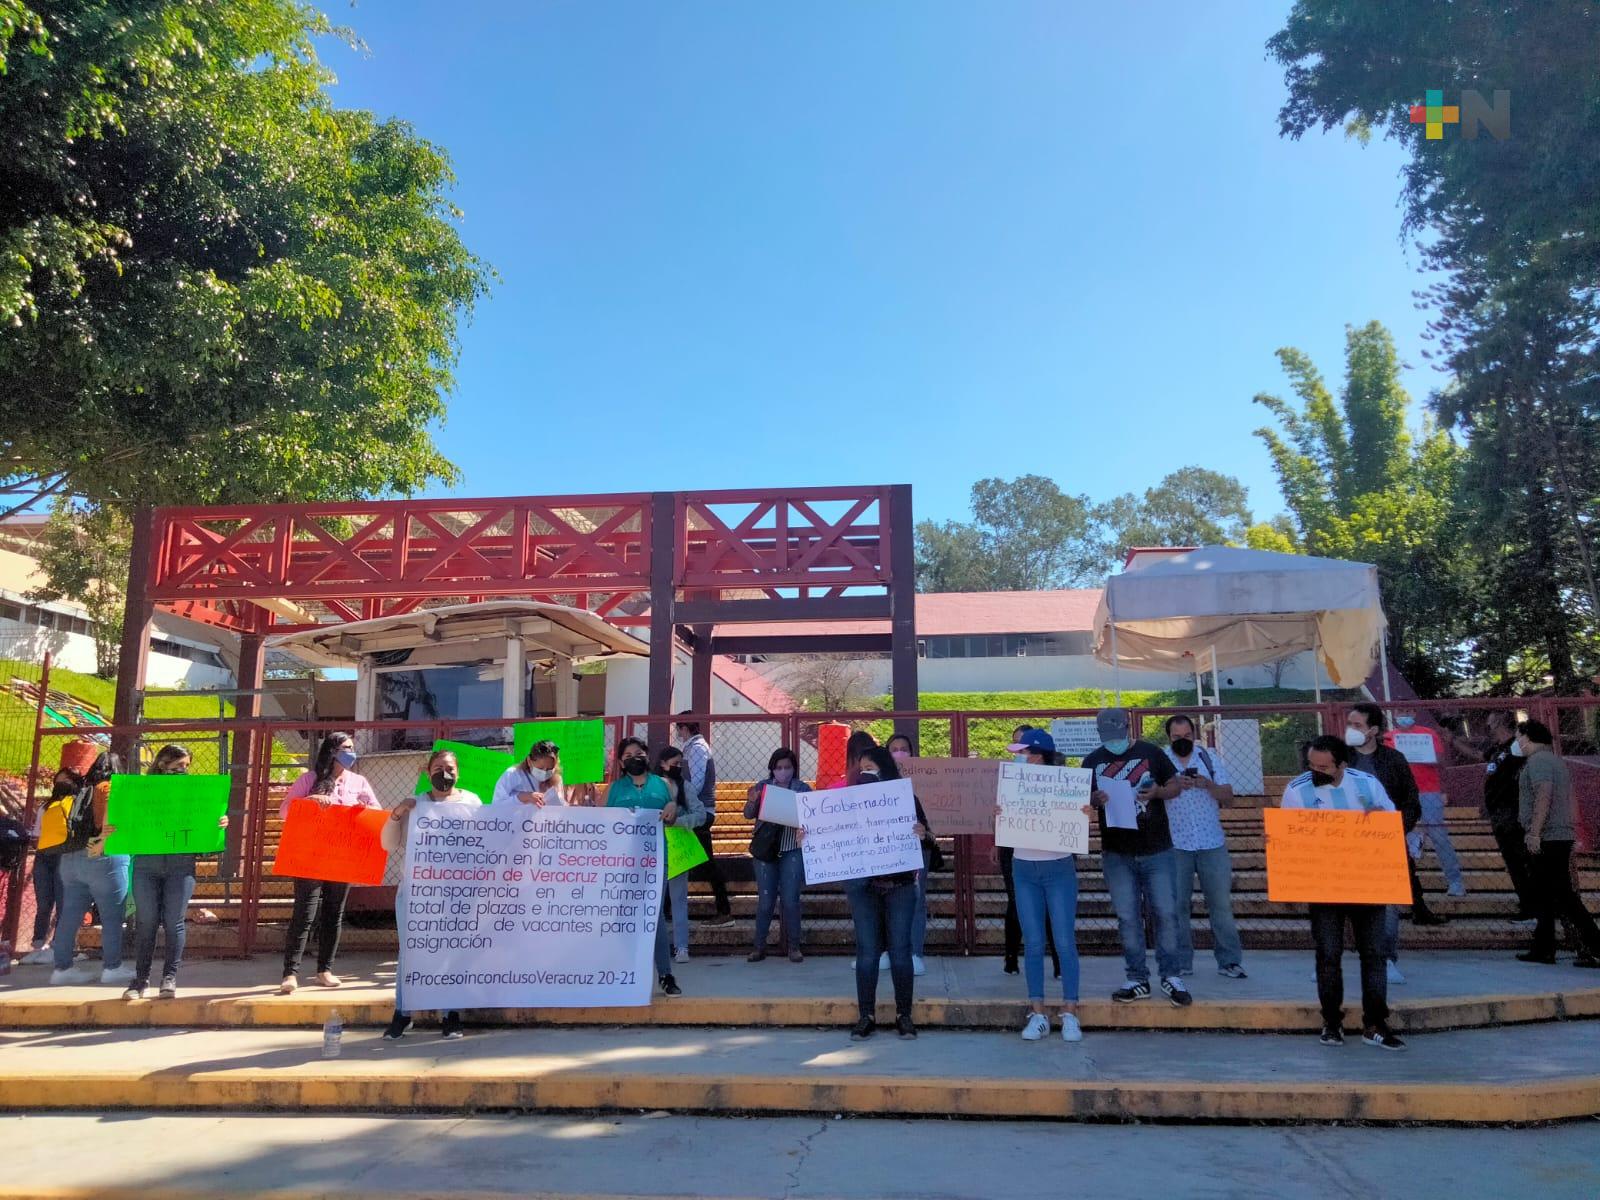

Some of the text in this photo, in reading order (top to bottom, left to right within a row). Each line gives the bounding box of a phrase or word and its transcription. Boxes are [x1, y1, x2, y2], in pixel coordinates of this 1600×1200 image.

[821, 793, 900, 815] Gobernador
[416, 816, 657, 836] Gobernador, Cuitláhuac García
[1288, 824, 1318, 835] BASE
[1326, 829, 1345, 839] DEL
[415, 832, 657, 852] Jiménez, solicitamos su
[804, 840, 816, 854] de
[873, 832, 885, 844] de
[414, 848, 657, 869] intervención en la Secretaria de
[806, 857, 823, 866] en
[827, 851, 837, 863] el
[412, 865, 657, 888] Educación de Veracruz para la
[411, 883, 657, 901] transparencia en el número
[409, 900, 656, 918] total de plazas e incrementar la
[407, 916, 656, 937] cantidad de vacantes para la
[406, 934, 492, 954] asignación
[597, 970, 636, 985] 20-21
